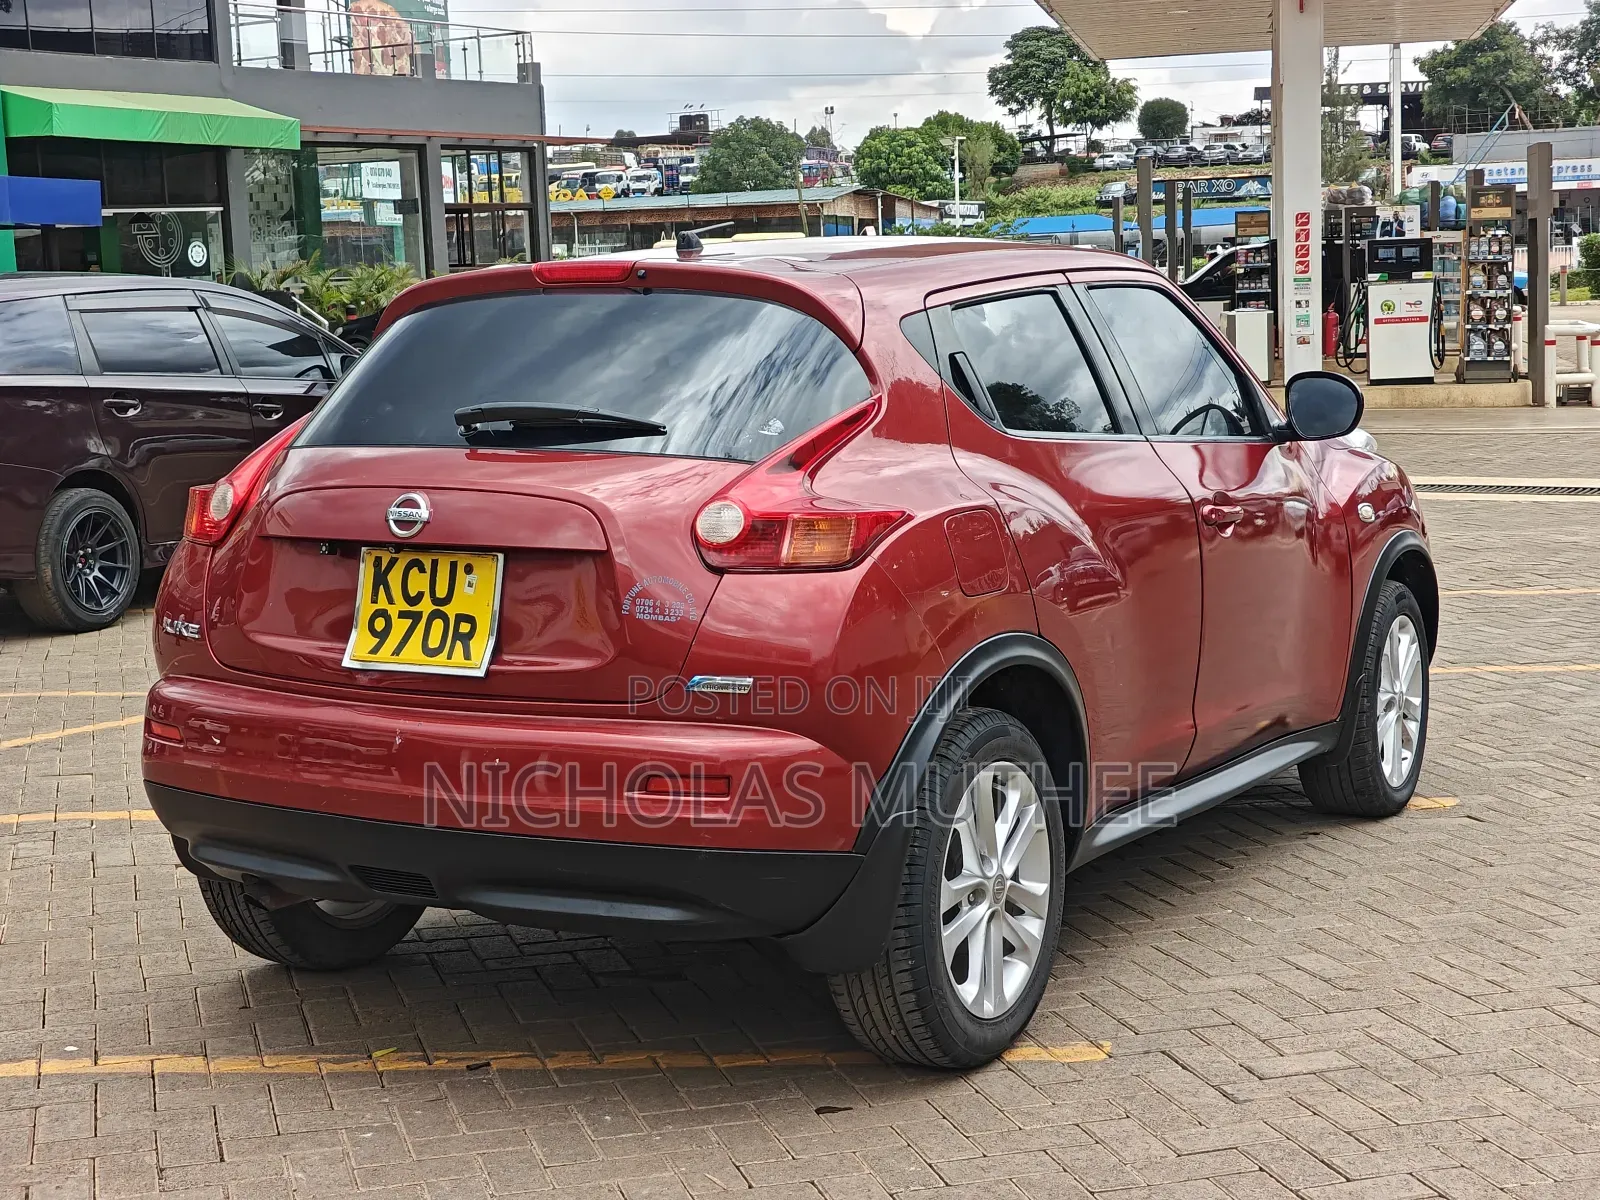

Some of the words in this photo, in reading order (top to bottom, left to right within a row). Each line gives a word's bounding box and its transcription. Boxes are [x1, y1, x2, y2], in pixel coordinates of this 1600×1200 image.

[1176, 180, 1208, 193] BAR
[1212, 179, 1236, 192] XO
[388, 510, 422, 518] NISSAN
[370, 556, 458, 607] KCU
[622, 582, 643, 615] FORTUNE
[643, 575, 688, 595] AUTOMOBILE
[367, 608, 478, 661] 970R
